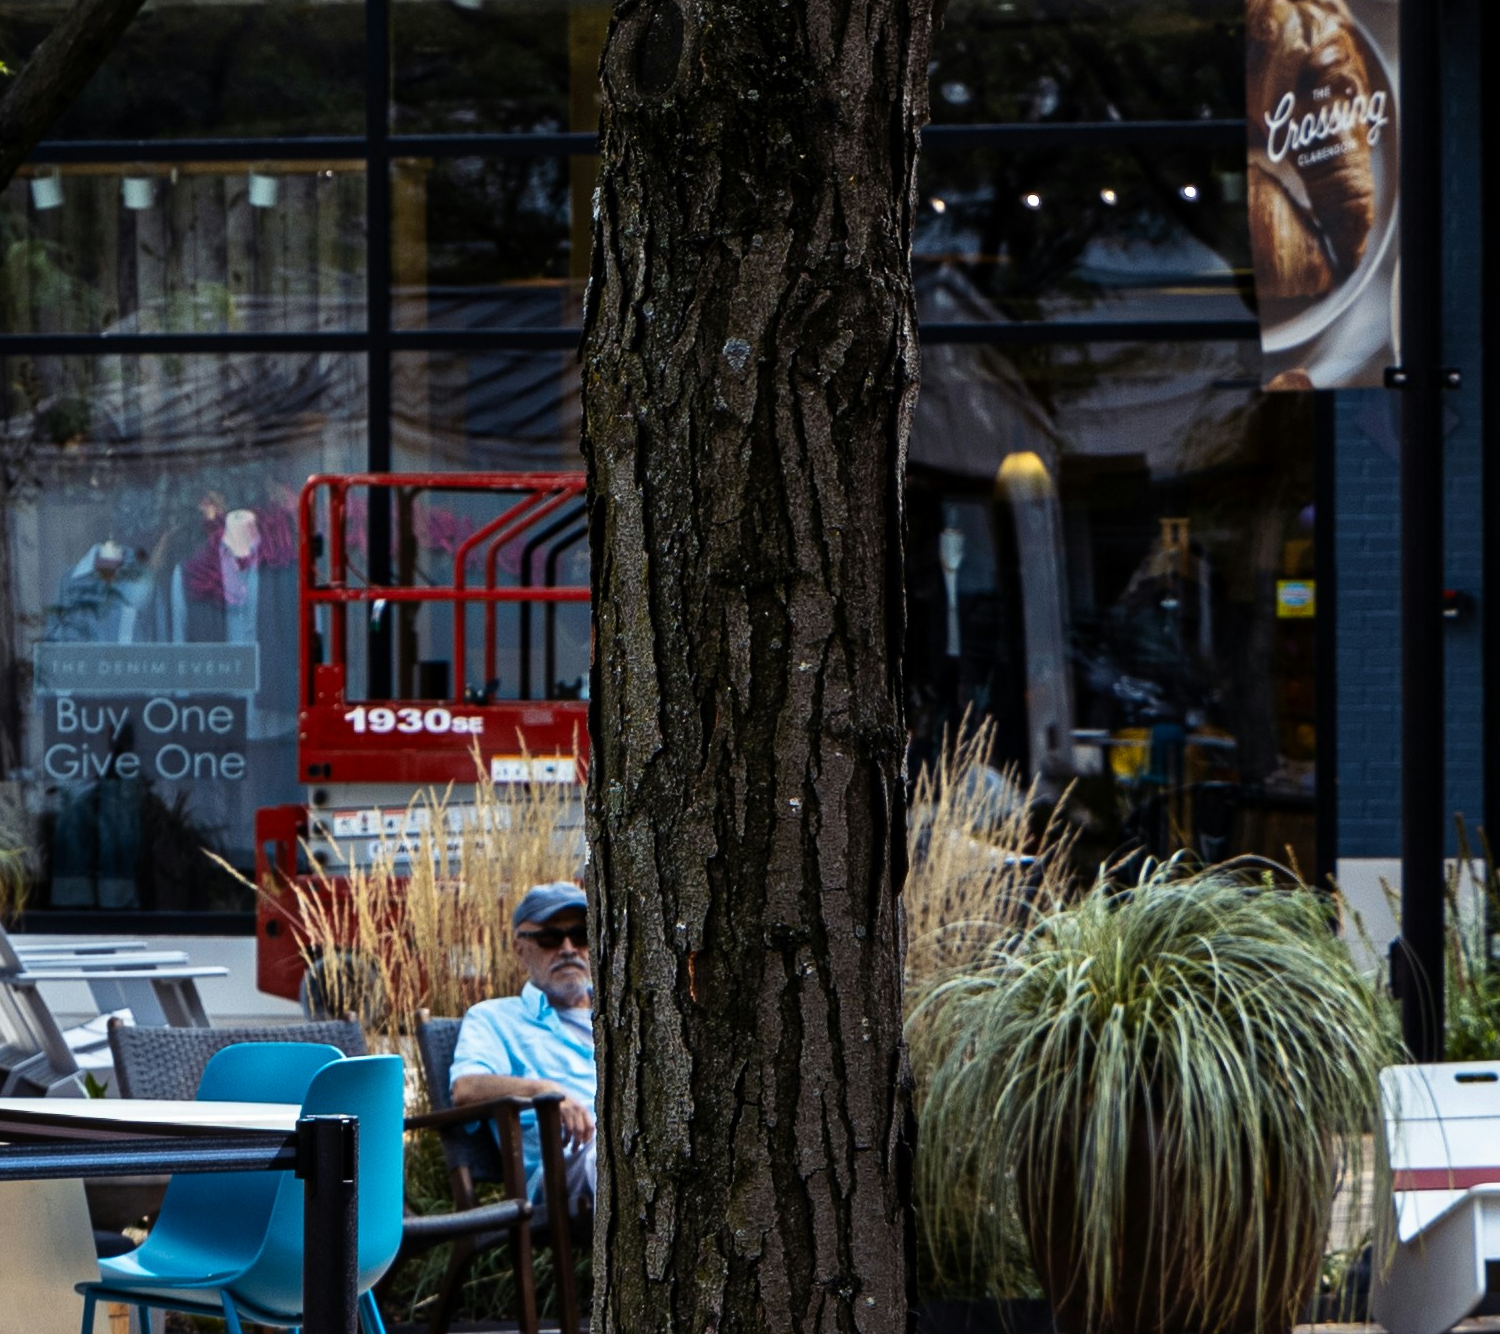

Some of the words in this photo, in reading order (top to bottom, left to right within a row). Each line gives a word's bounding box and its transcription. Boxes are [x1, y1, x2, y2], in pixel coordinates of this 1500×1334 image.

[1264, 90, 1389, 163] Crossing
[53, 660, 86, 675] THE
[99, 660, 166, 675] DENIM
[178, 660, 243, 675] EVENT
[57, 696, 130, 741] Buy
[143, 697, 235, 734] One
[44, 743, 141, 780] Give
[155, 743, 246, 780] One
